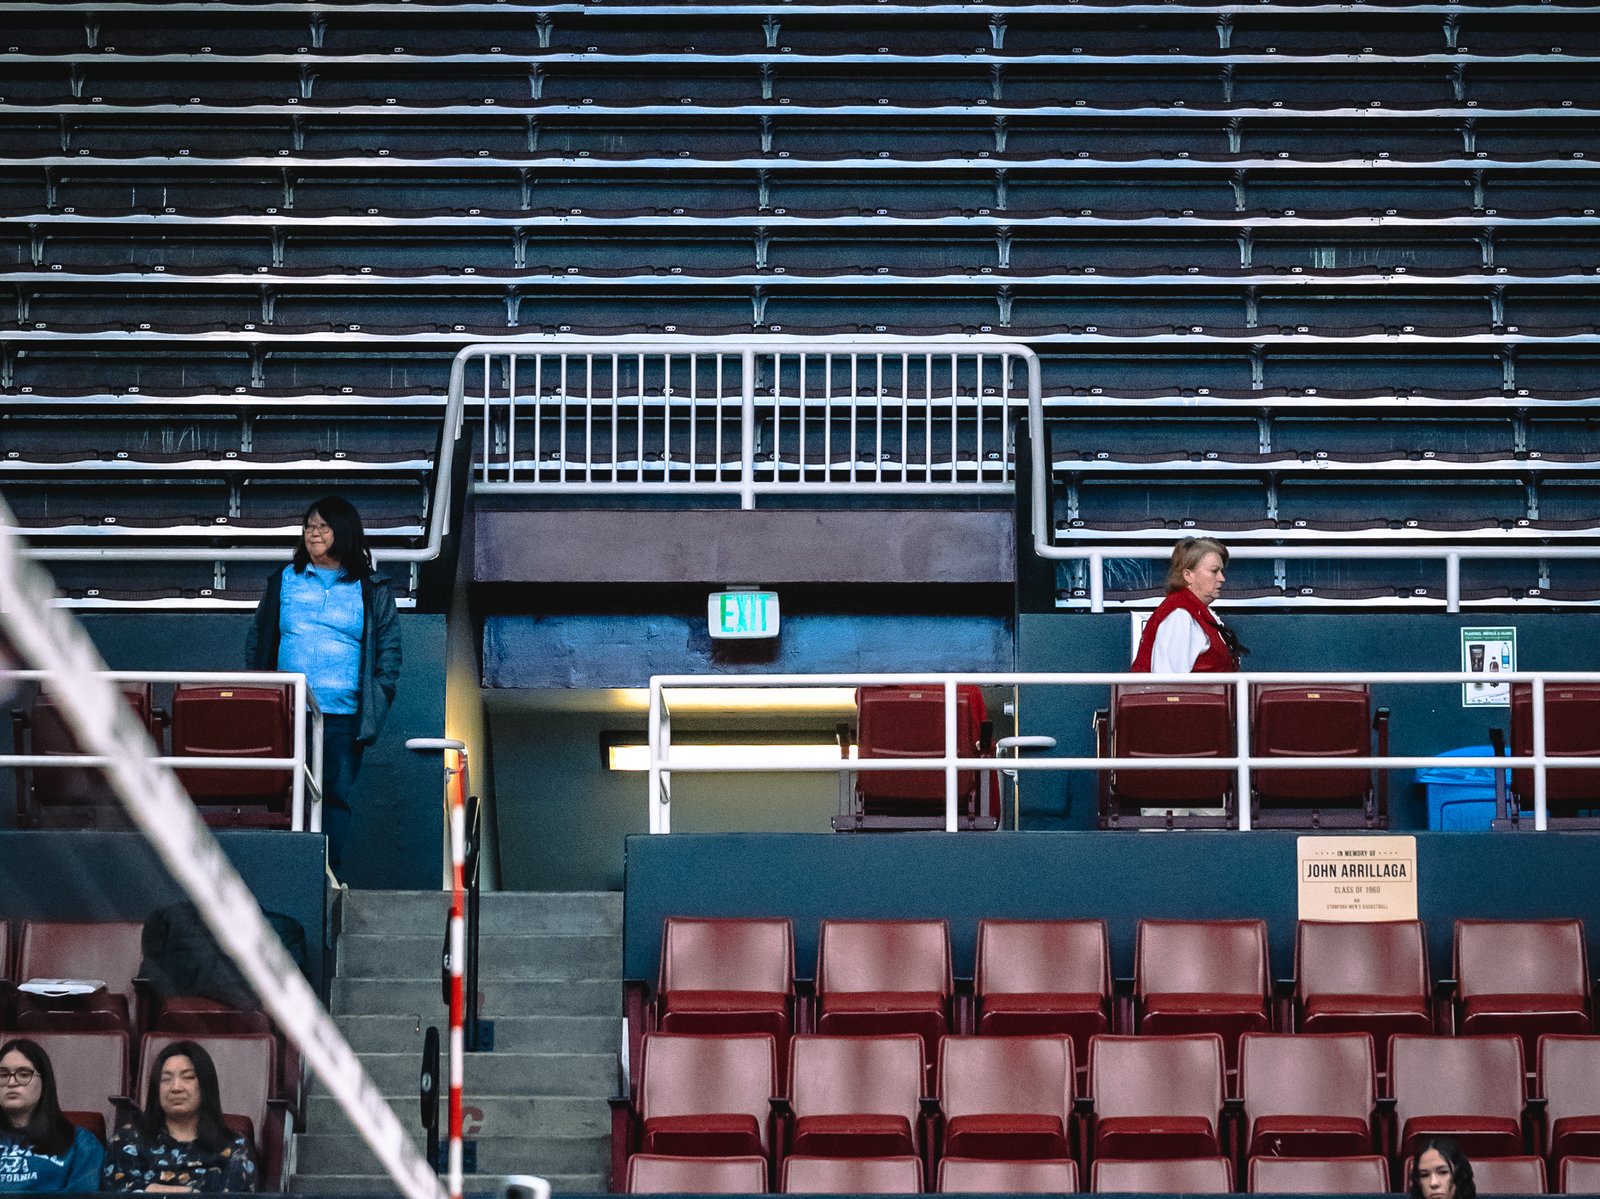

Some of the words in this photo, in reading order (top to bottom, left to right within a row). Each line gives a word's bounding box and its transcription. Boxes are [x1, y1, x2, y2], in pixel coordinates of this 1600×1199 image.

[720, 594, 769, 632] EXIT
[1307, 864, 1337, 878] JOHN
[1341, 863, 1407, 878] ARRILLAGA
[1334, 886, 1354, 894] CLASS
[1355, 886, 1363, 894] OF
[1365, 886, 1381, 894] 1960
